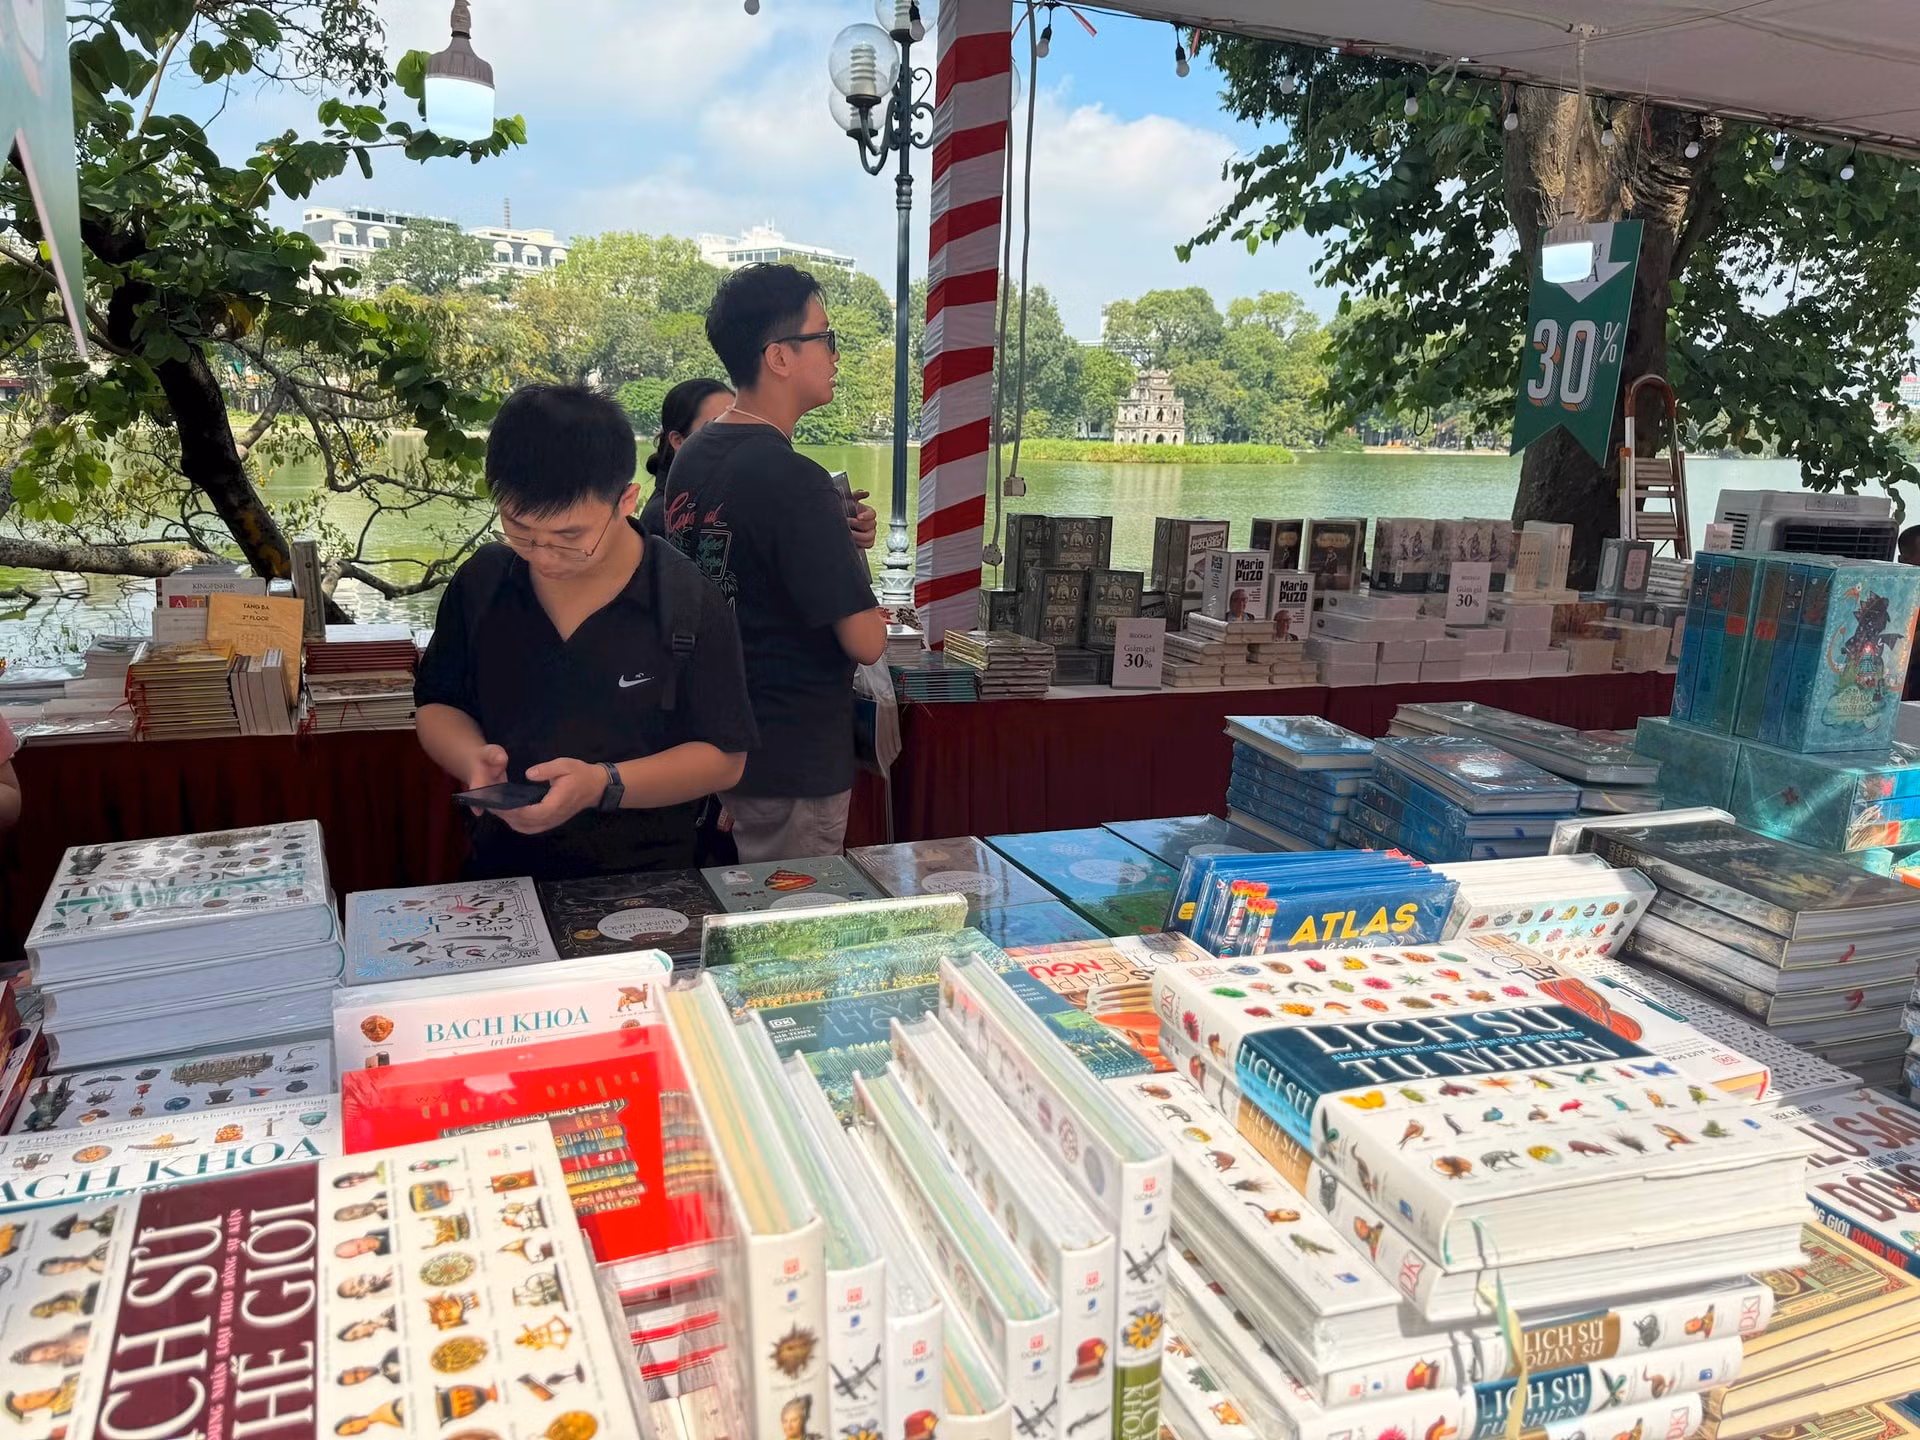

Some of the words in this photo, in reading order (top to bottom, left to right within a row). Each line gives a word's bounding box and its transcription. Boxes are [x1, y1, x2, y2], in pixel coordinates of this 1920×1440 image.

[1527, 318, 1623, 411] 30%
[1236, 559, 1264, 570] Mario
[1280, 580, 1308, 591] Mario
[1455, 593, 1480, 608] 30%
[1124, 644, 1144, 652] Giảm
[1124, 653, 1153, 669] 30%
[1288, 903, 1419, 946] ATLAS
[424, 1016, 504, 1044] BÁCH
[512, 1006, 590, 1034] KHOA
[770, 1017, 795, 1028] DK
[818, 1003, 904, 1025] THAY
[1297, 1014, 1481, 1054] LỊCH
[1472, 1005, 1576, 1037] SỬ
[506, 1034, 532, 1046] thức
[1789, 1103, 1825, 1117] HARVEY
[146, 1136, 327, 1183] KHOA
[124, 1213, 224, 1308] SỬ
[240, 1197, 316, 1329] GIỚI
[219, 1290, 235, 1322] THEO
[1579, 1318, 1605, 1345] SỬ
[99, 1316, 211, 1440] CH
[230, 1340, 315, 1440] HẾ
[1552, 1372, 1586, 1404] SỬ
